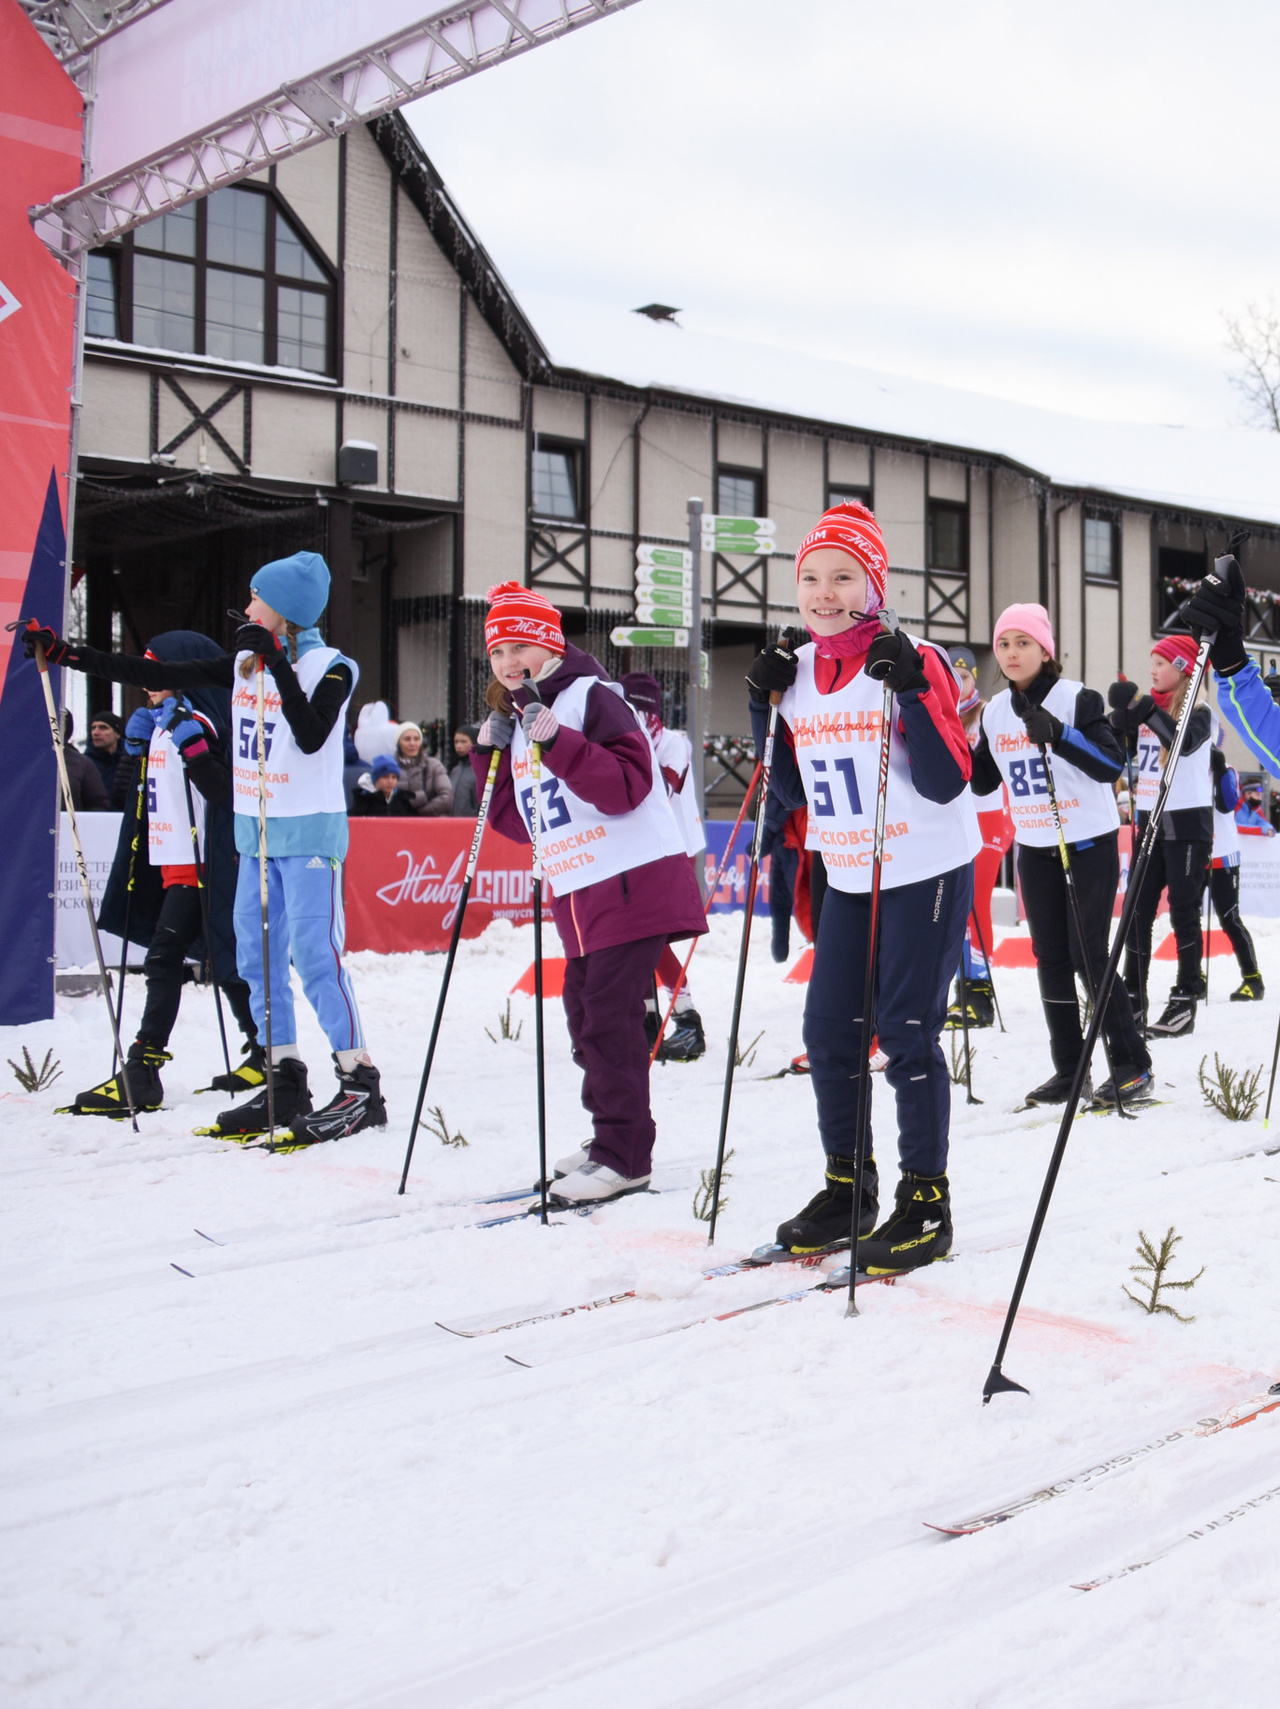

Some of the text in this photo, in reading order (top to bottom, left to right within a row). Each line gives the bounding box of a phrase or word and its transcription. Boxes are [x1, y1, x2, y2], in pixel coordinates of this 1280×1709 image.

[506, 619, 546, 642] Живу
[232, 765, 289, 783] ОСКОВКАЯ
[235, 783, 274, 799] ОБЛАСЬ
[1007, 798, 1080, 816] ОСКОВКАЯ
[466, 799, 489, 863] Quechua
[1019, 815, 1069, 829] ОБЛАСЬ
[541, 825, 607, 861] СКОВСКАЯ
[376, 849, 466, 931] Живу
[932, 879, 944, 923] NORDSKI
[318, 1106, 367, 1132] SPINE
[890, 1231, 937, 1255] FISCHER
